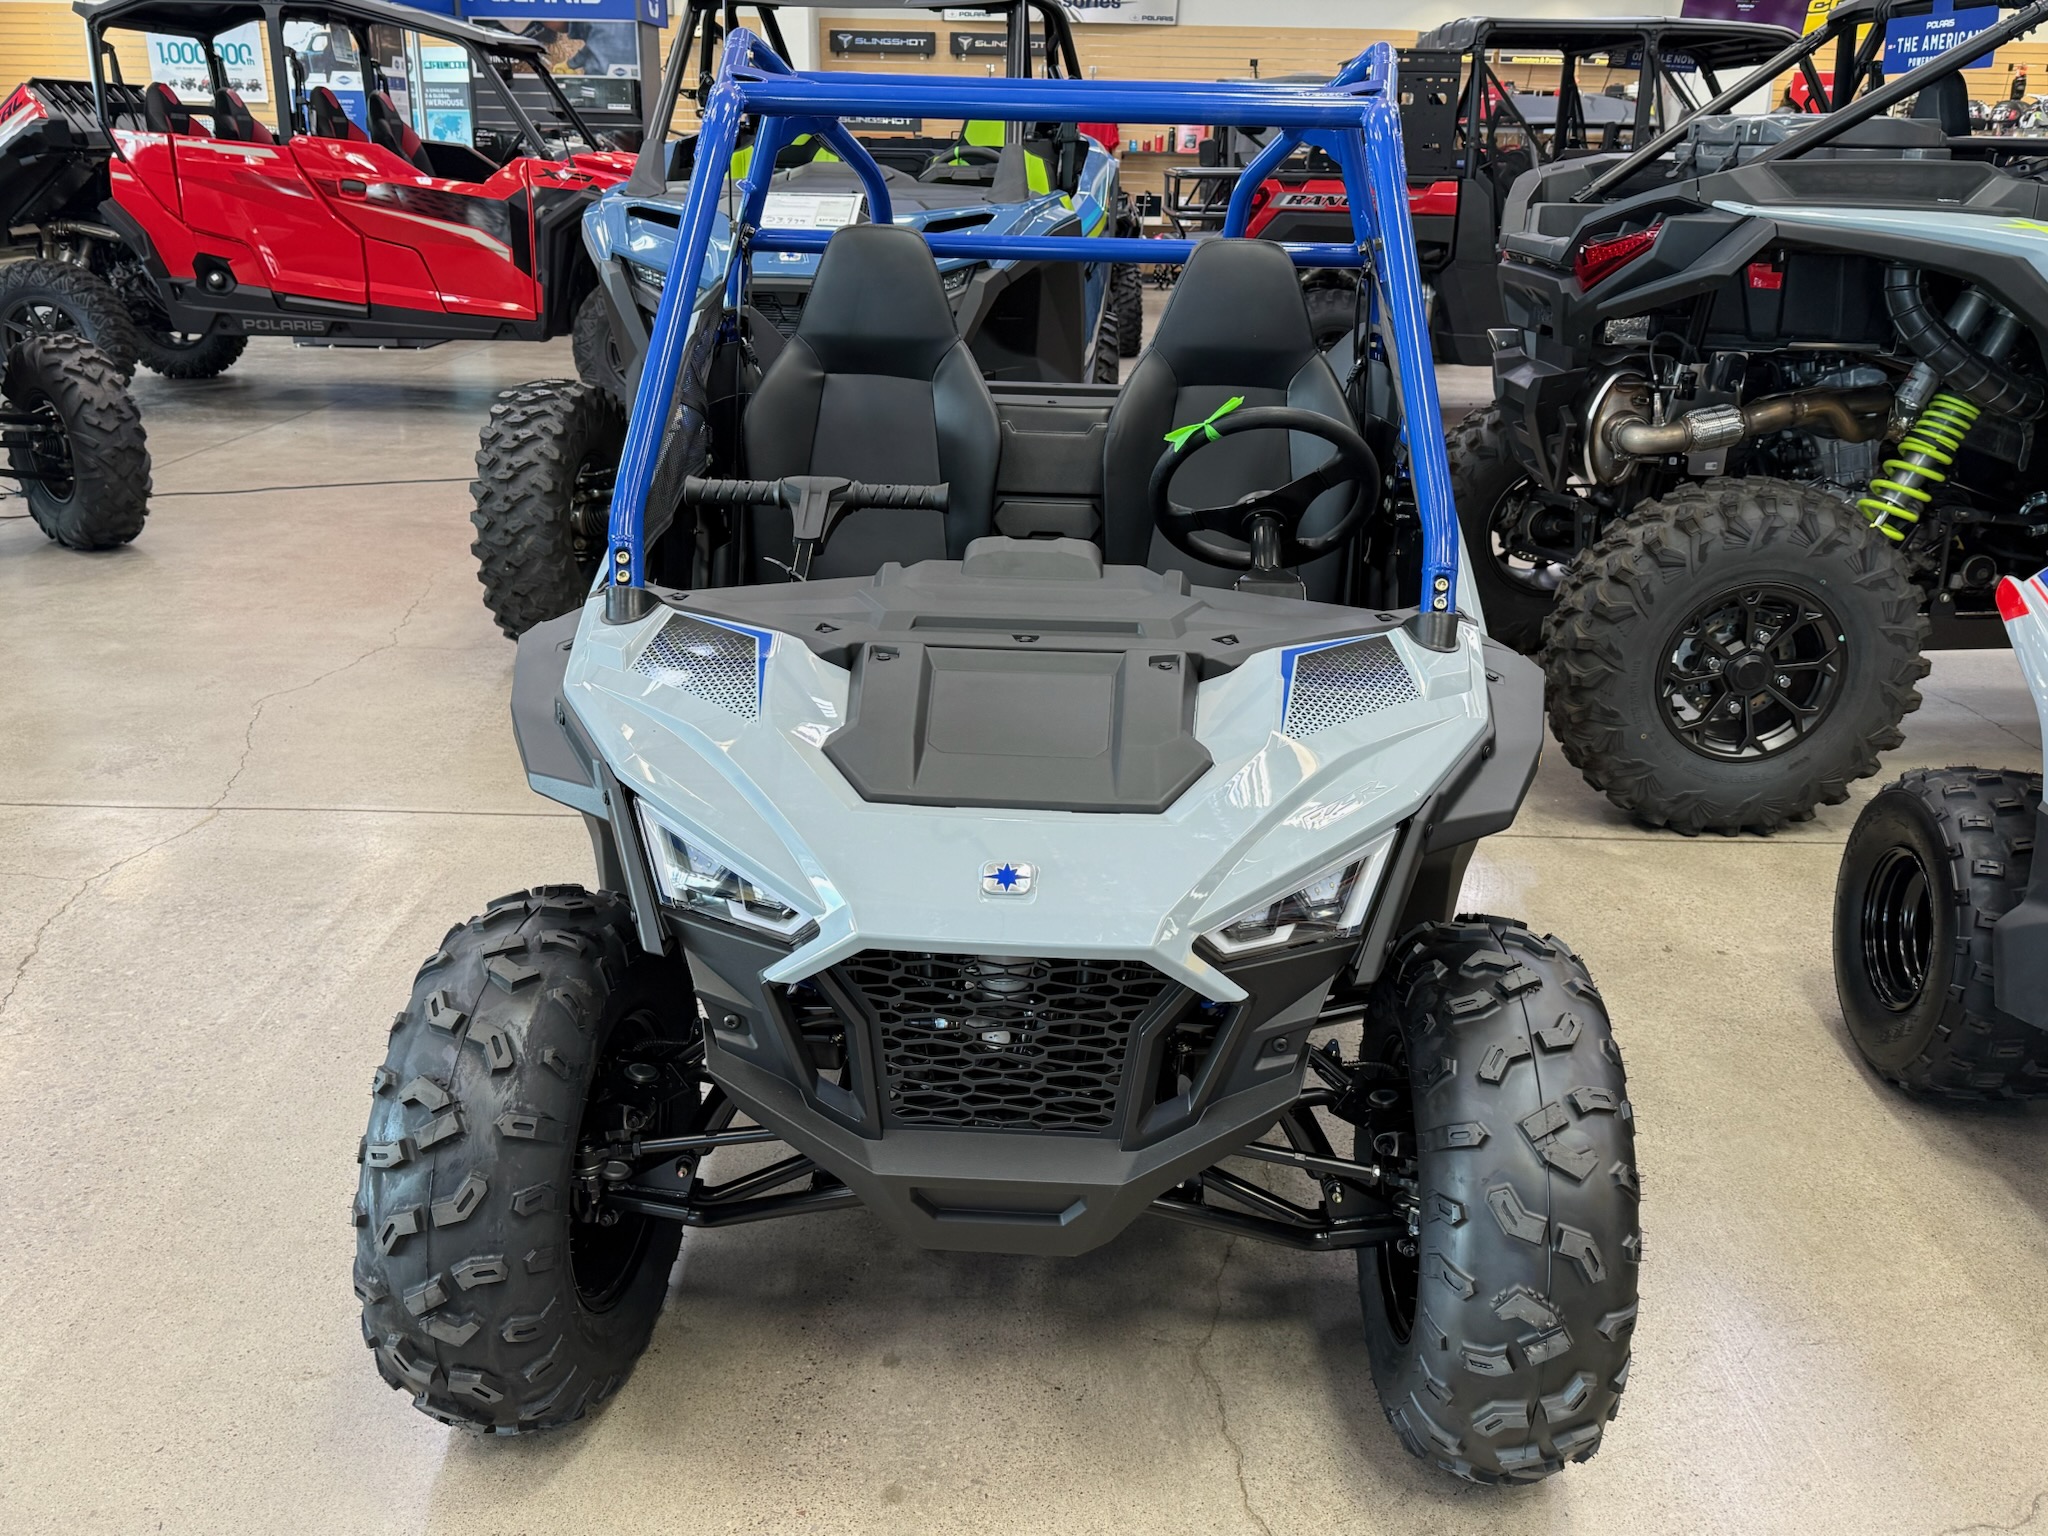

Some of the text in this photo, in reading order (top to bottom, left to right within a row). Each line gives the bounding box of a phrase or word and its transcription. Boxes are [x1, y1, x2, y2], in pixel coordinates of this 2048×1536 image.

[1926, 19, 1955, 30] POLARIS
[855, 37, 927, 47] SLINGSHOT
[974, 40, 1046, 49] SLINOT
[1897, 29, 1984, 54] THE AMERICA
[838, 116, 913, 125] SLINGSHOT
[242, 319, 326, 332] POLARIS
